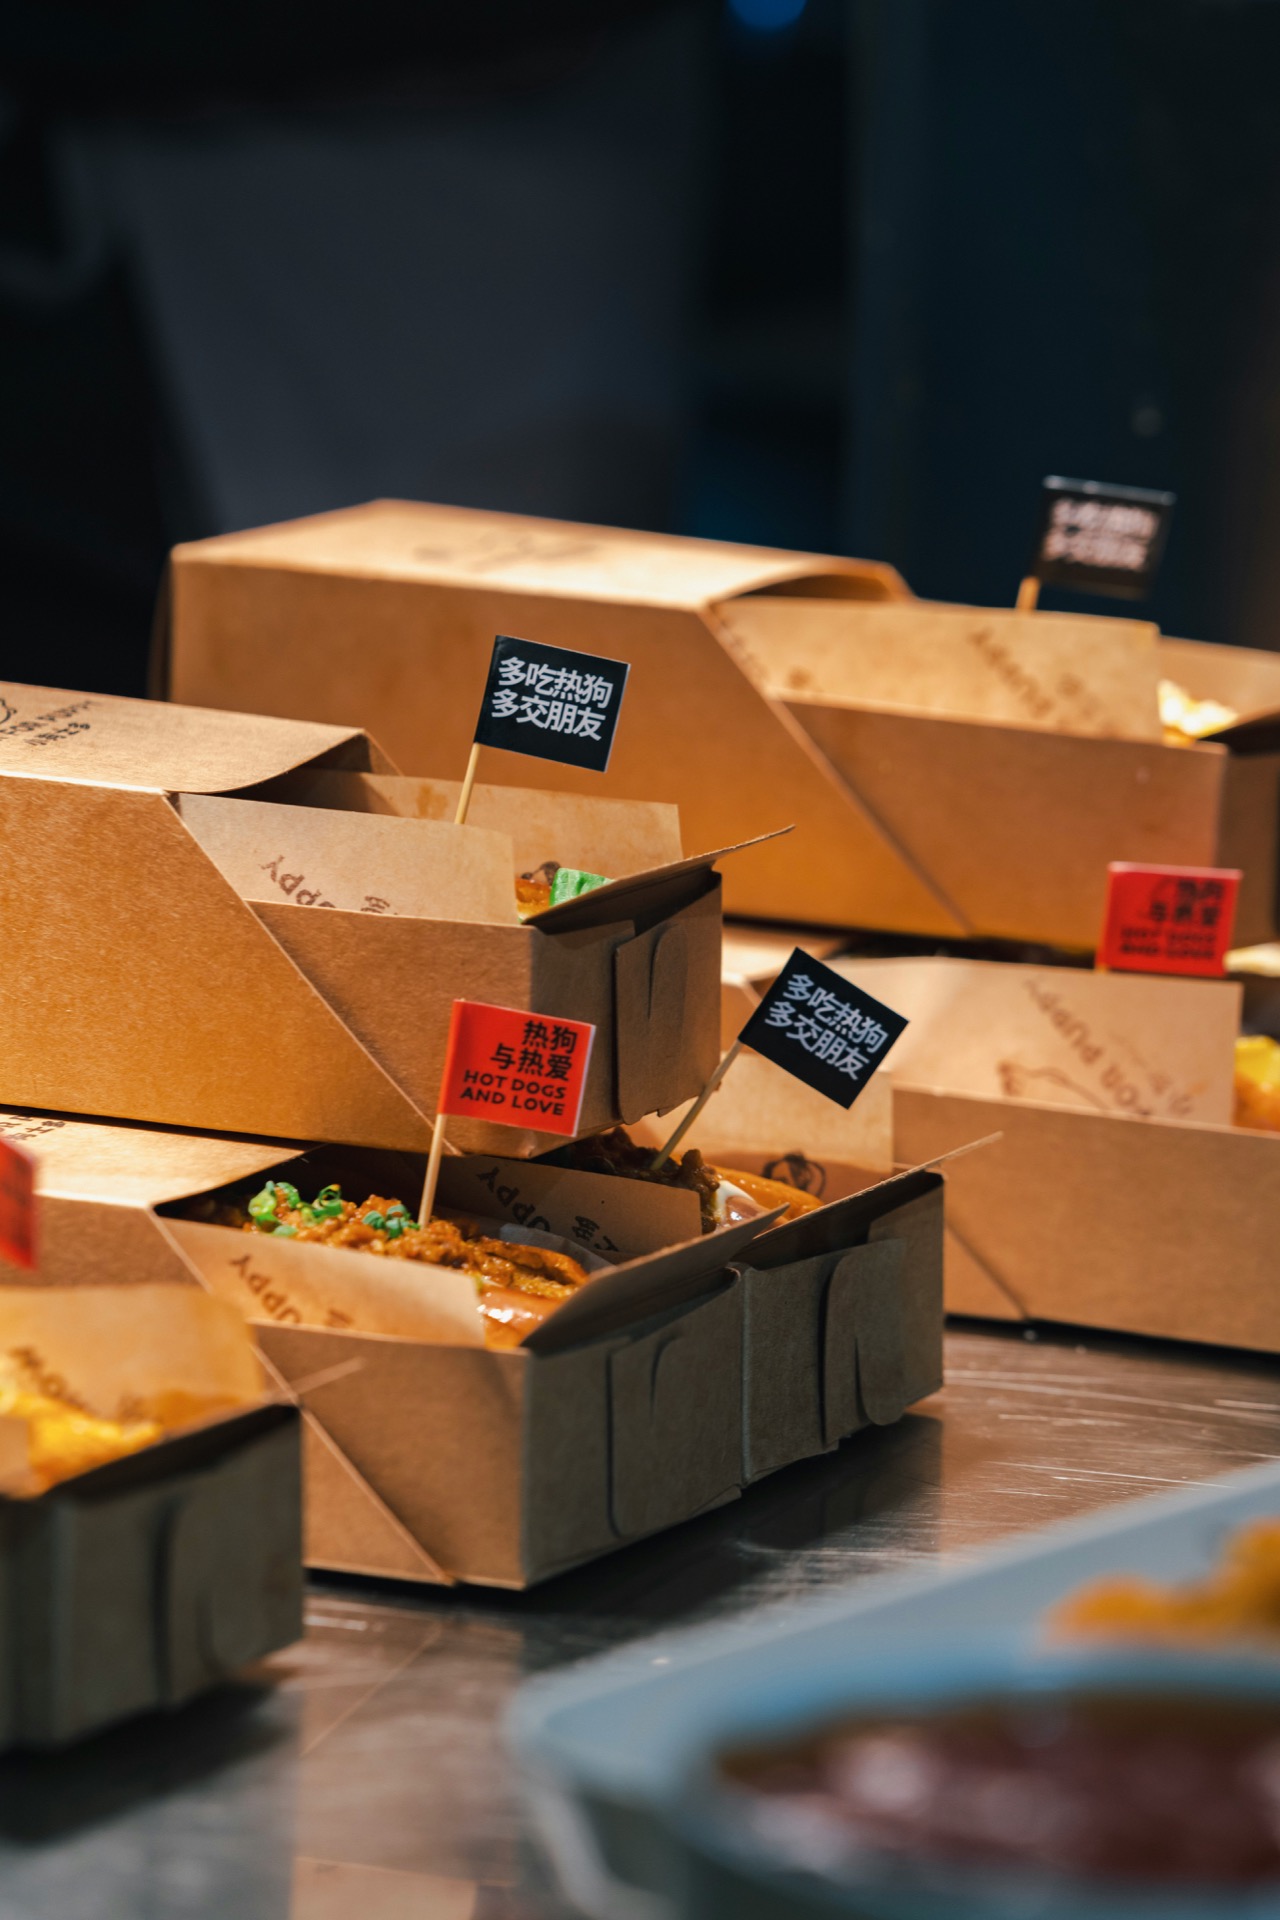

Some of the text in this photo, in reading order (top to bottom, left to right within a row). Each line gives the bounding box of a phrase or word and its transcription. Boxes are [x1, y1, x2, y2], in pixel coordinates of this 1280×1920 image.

[498, 656, 614, 709] 多吃热狗
[491, 688, 606, 741] 多交朋友
[782, 973, 889, 1053] 多吃热狗
[522, 1019, 578, 1054] 热狗
[764, 1001, 870, 1080] 多交朋友
[463, 1069, 567, 1099] HOT DOGS
[490, 1043, 573, 1082] 与热爱
[460, 1087, 566, 1116] AND LOVE
